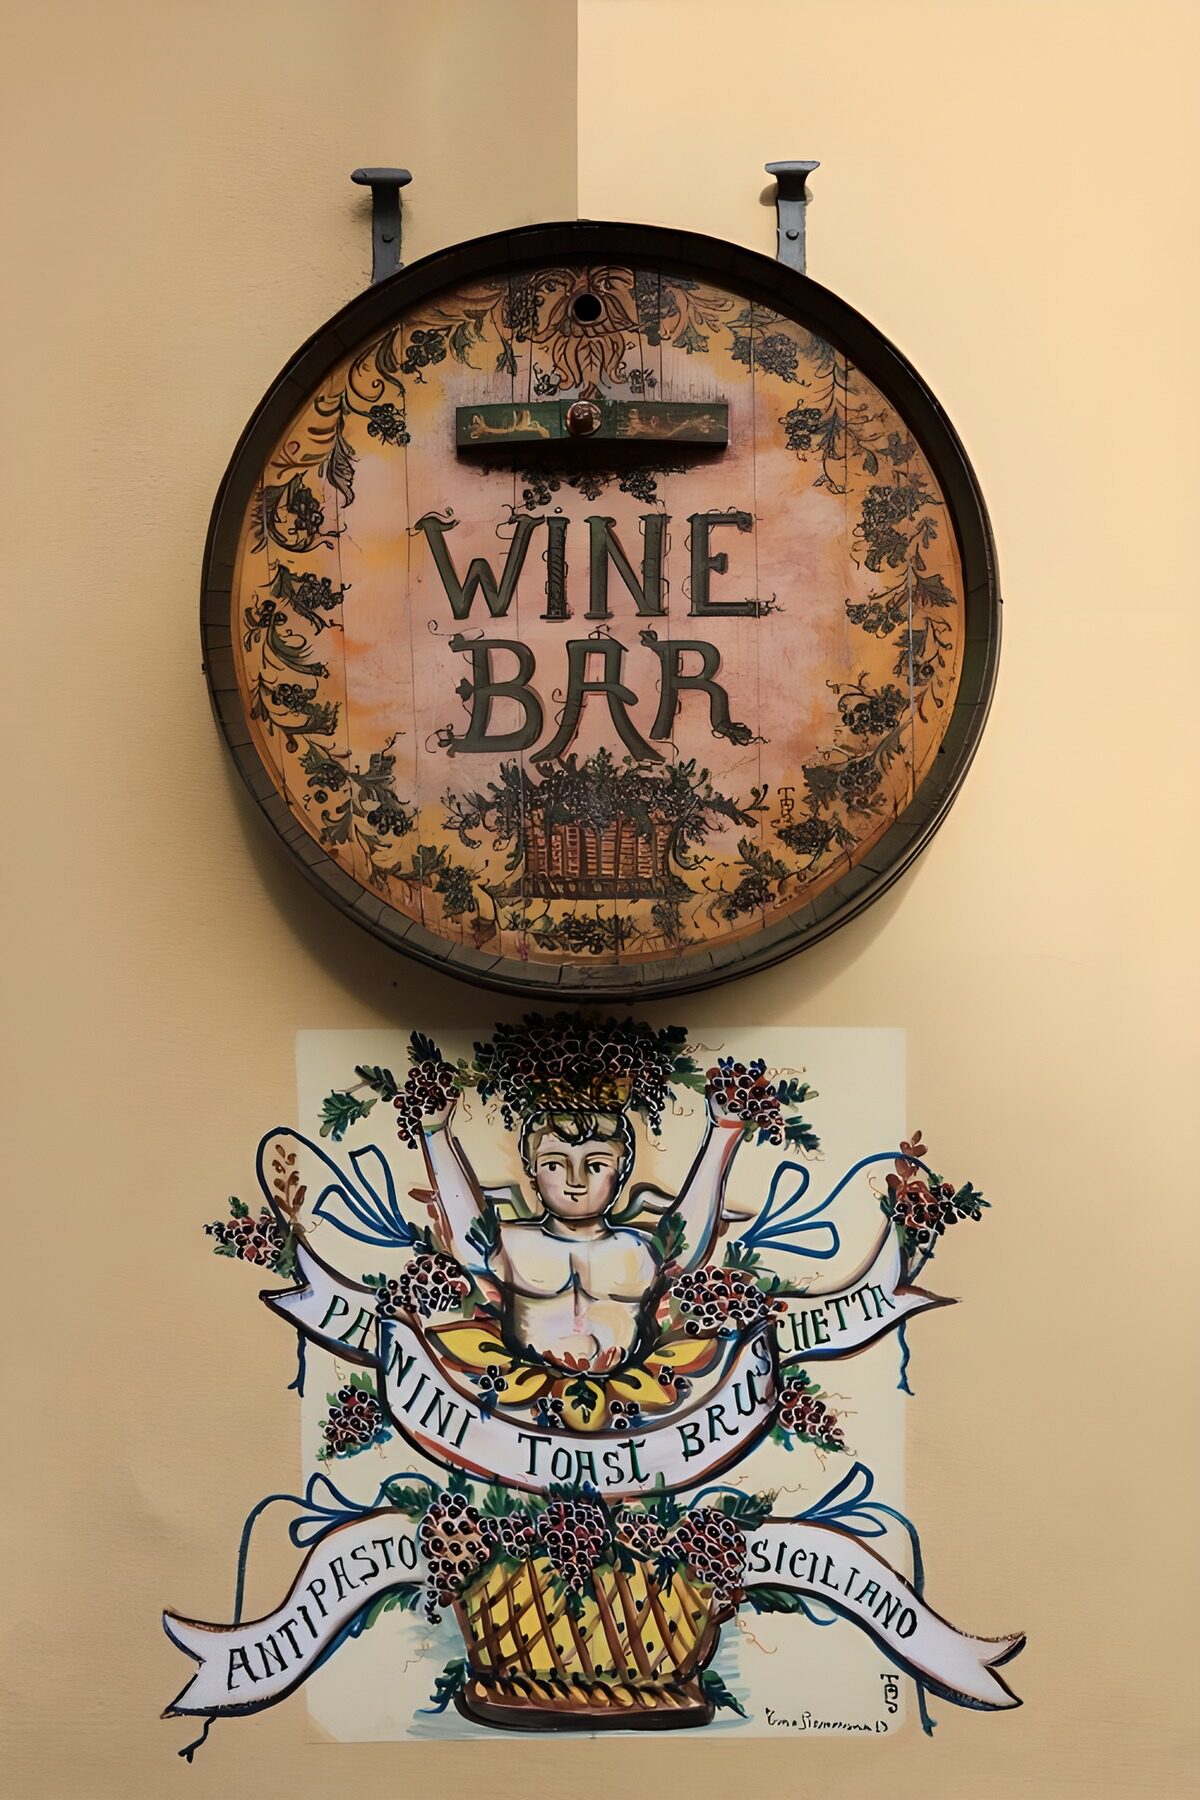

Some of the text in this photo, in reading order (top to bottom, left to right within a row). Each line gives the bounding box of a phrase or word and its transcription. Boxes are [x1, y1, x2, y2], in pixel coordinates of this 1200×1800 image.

[409, 506, 764, 622] WINE
[446, 628, 756, 765] BAR
[318, 1294, 478, 1451] PANINI
[517, 1432, 650, 1486] TOAST
[226, 1534, 418, 1691] ANTIPASTO
[748, 1538, 918, 1639] SICILIANO
